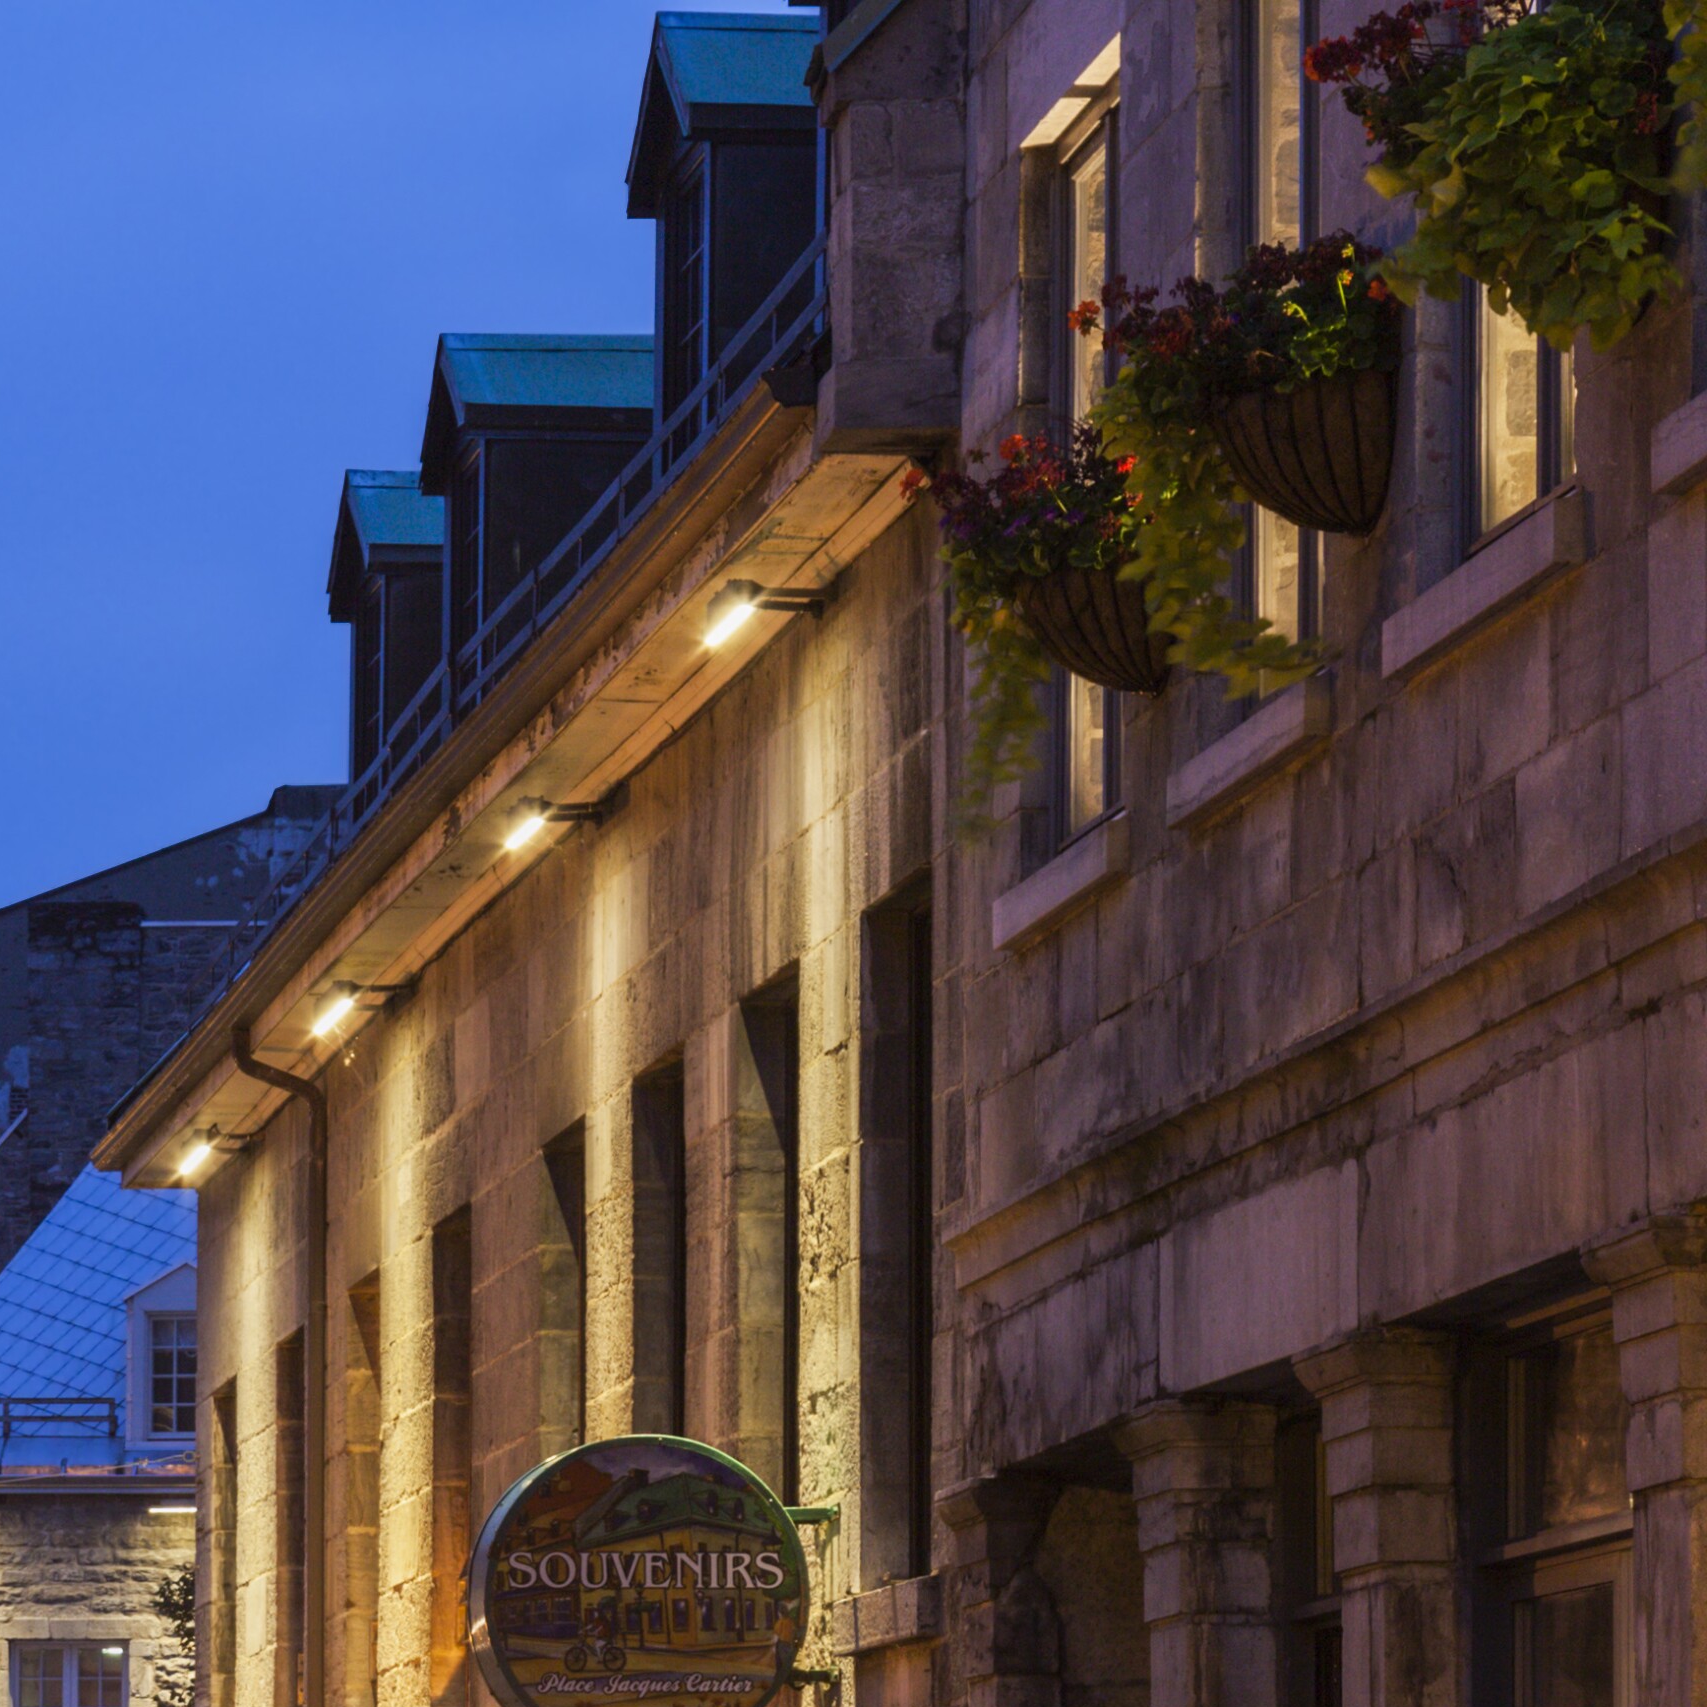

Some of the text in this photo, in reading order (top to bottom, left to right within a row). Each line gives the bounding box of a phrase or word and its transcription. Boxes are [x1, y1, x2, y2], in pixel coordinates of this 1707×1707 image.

[507, 1551, 785, 1589] SOUVENIRS
[538, 1672, 753, 1698] Place Jacques Cartier
